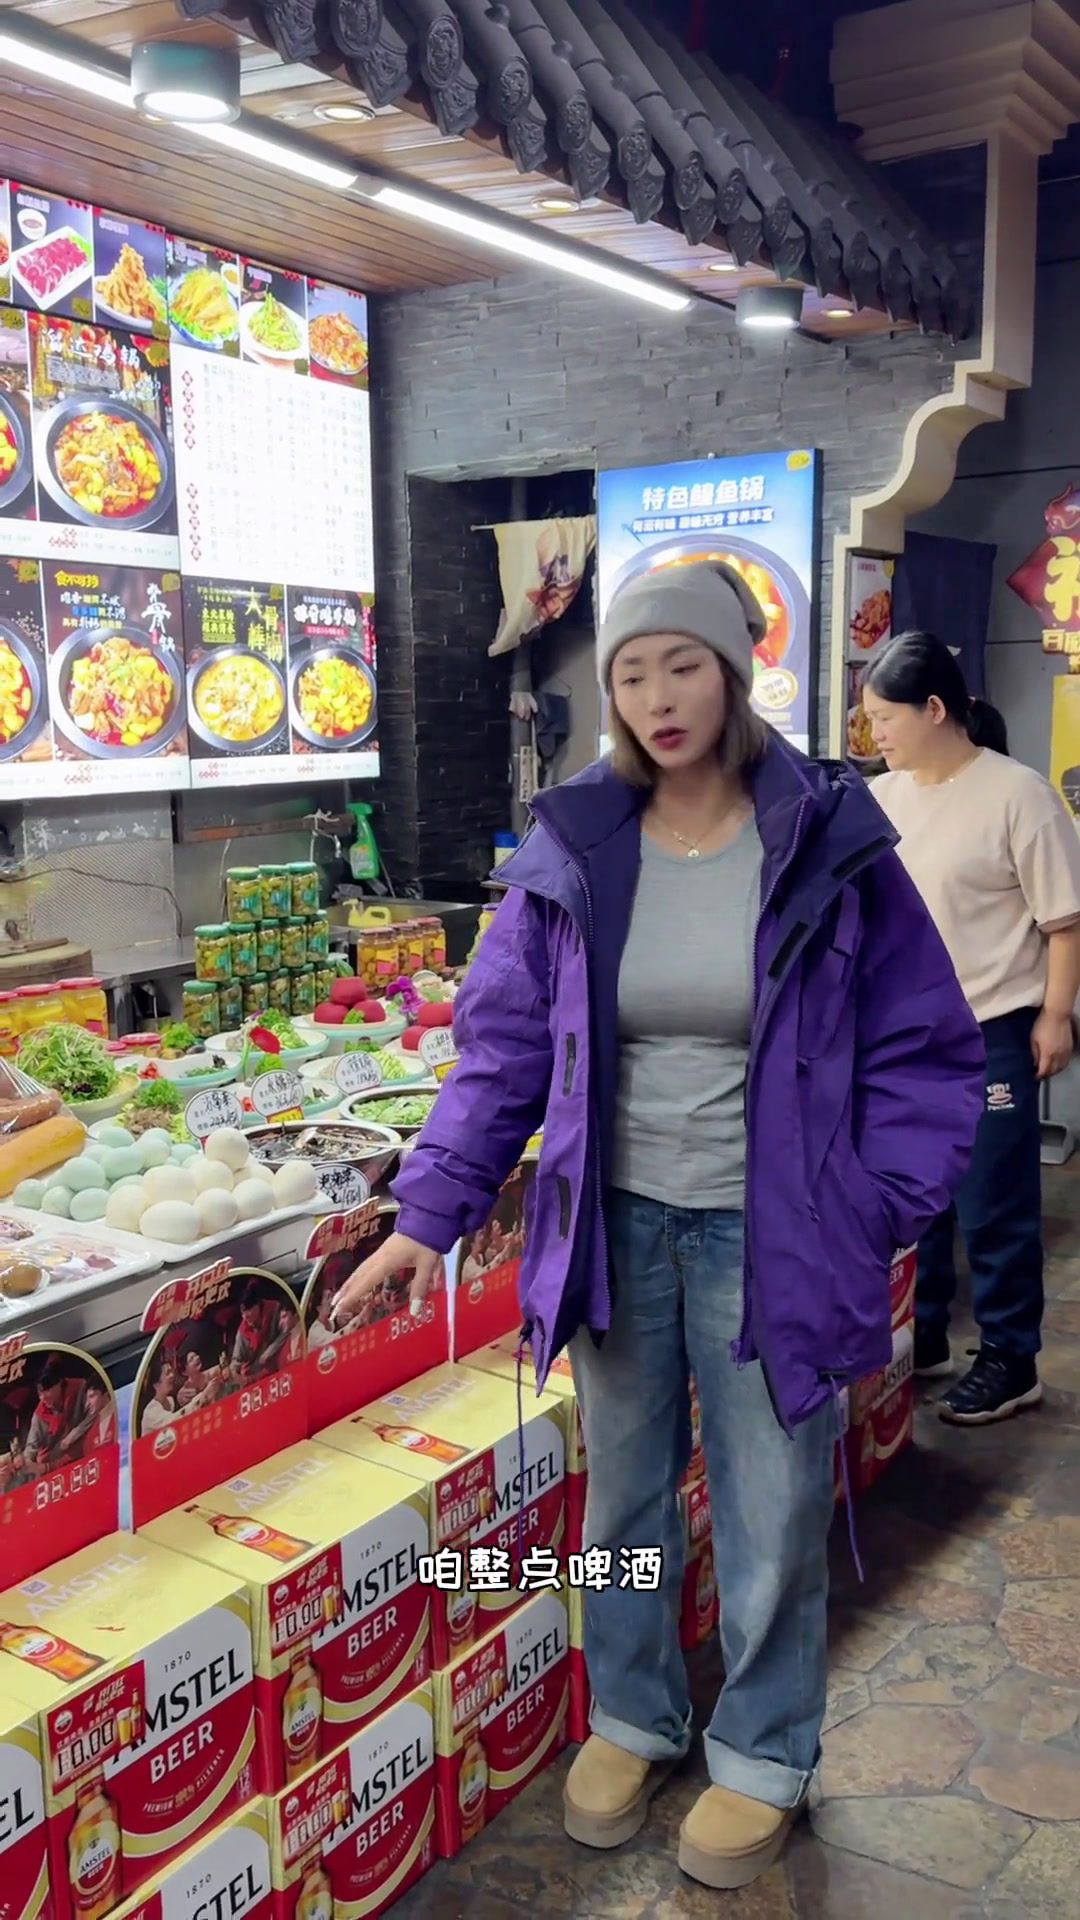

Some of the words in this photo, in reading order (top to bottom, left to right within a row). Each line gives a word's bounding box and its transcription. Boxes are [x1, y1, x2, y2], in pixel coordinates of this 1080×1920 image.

[28, 1553, 147, 1619] AMSTEL
[347, 1606, 398, 1659] BEER
[164, 1650, 191, 1673] 1870
[507, 1683, 545, 1733] BEER
[58, 1717, 115, 1777] 10.00
[150, 1719, 215, 1785] BEER
[356, 1801, 404, 1858] BEER
[80, 1847, 111, 1873] AMSTEL
